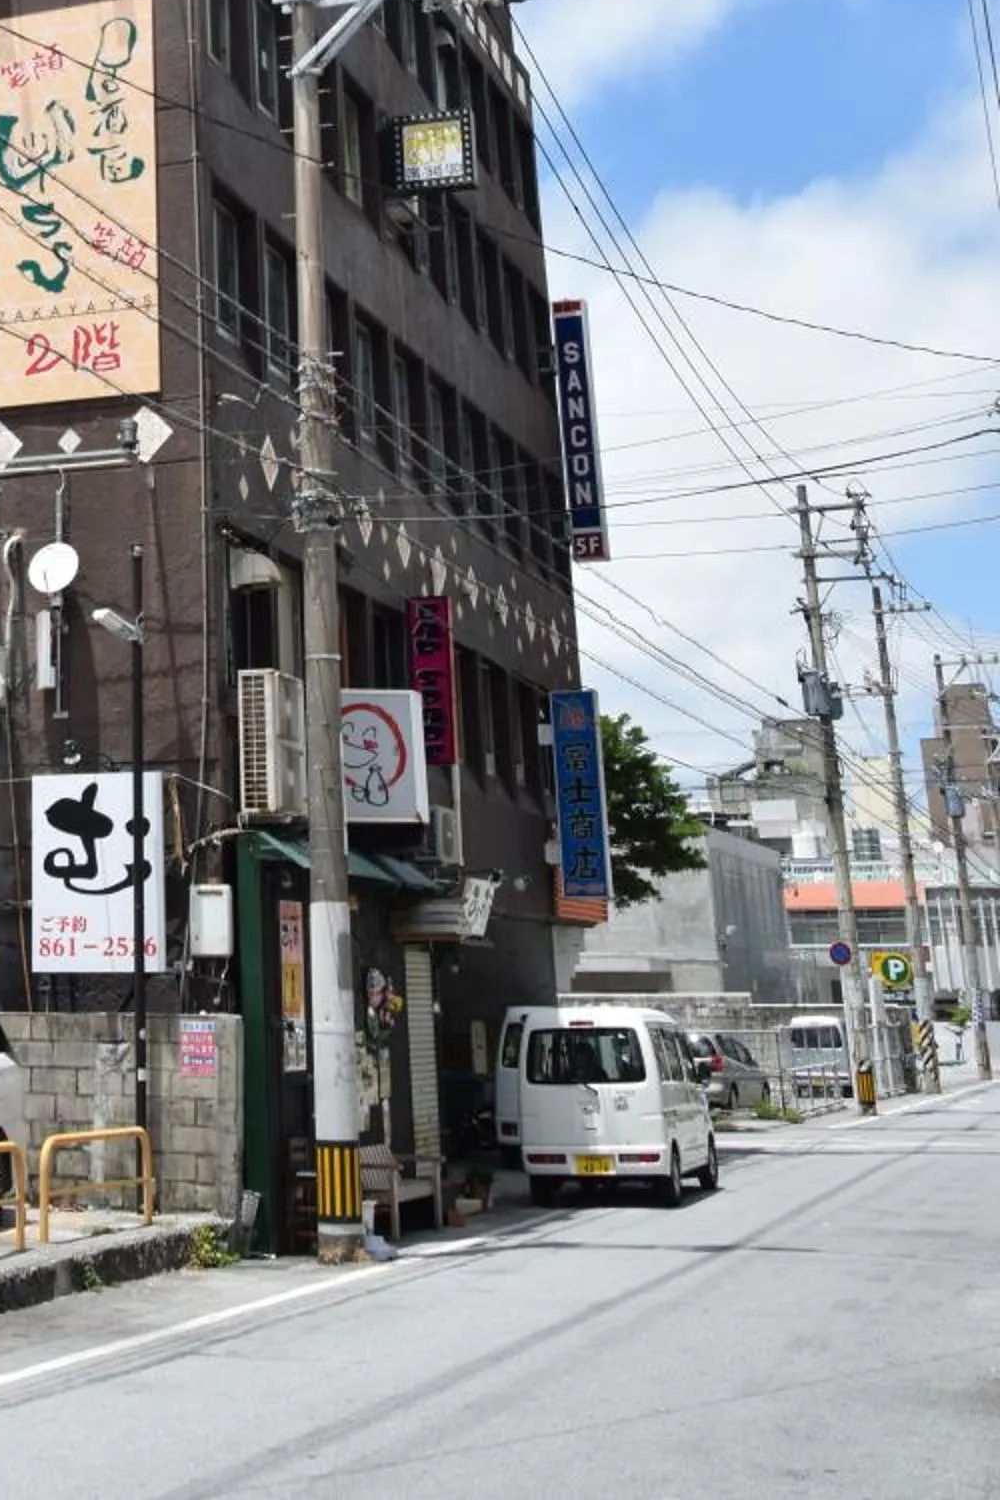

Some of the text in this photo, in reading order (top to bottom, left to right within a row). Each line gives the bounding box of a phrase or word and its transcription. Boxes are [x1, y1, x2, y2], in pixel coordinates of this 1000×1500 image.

[25, 320, 122, 377] 2階
[563, 340, 594, 506] SANCON
[574, 535, 601, 556] 5F
[43, 782, 152, 895] む
[39, 915, 88, 933] ご予約
[38, 935, 158, 958] 861-256
[887, 959, 905, 980] P
